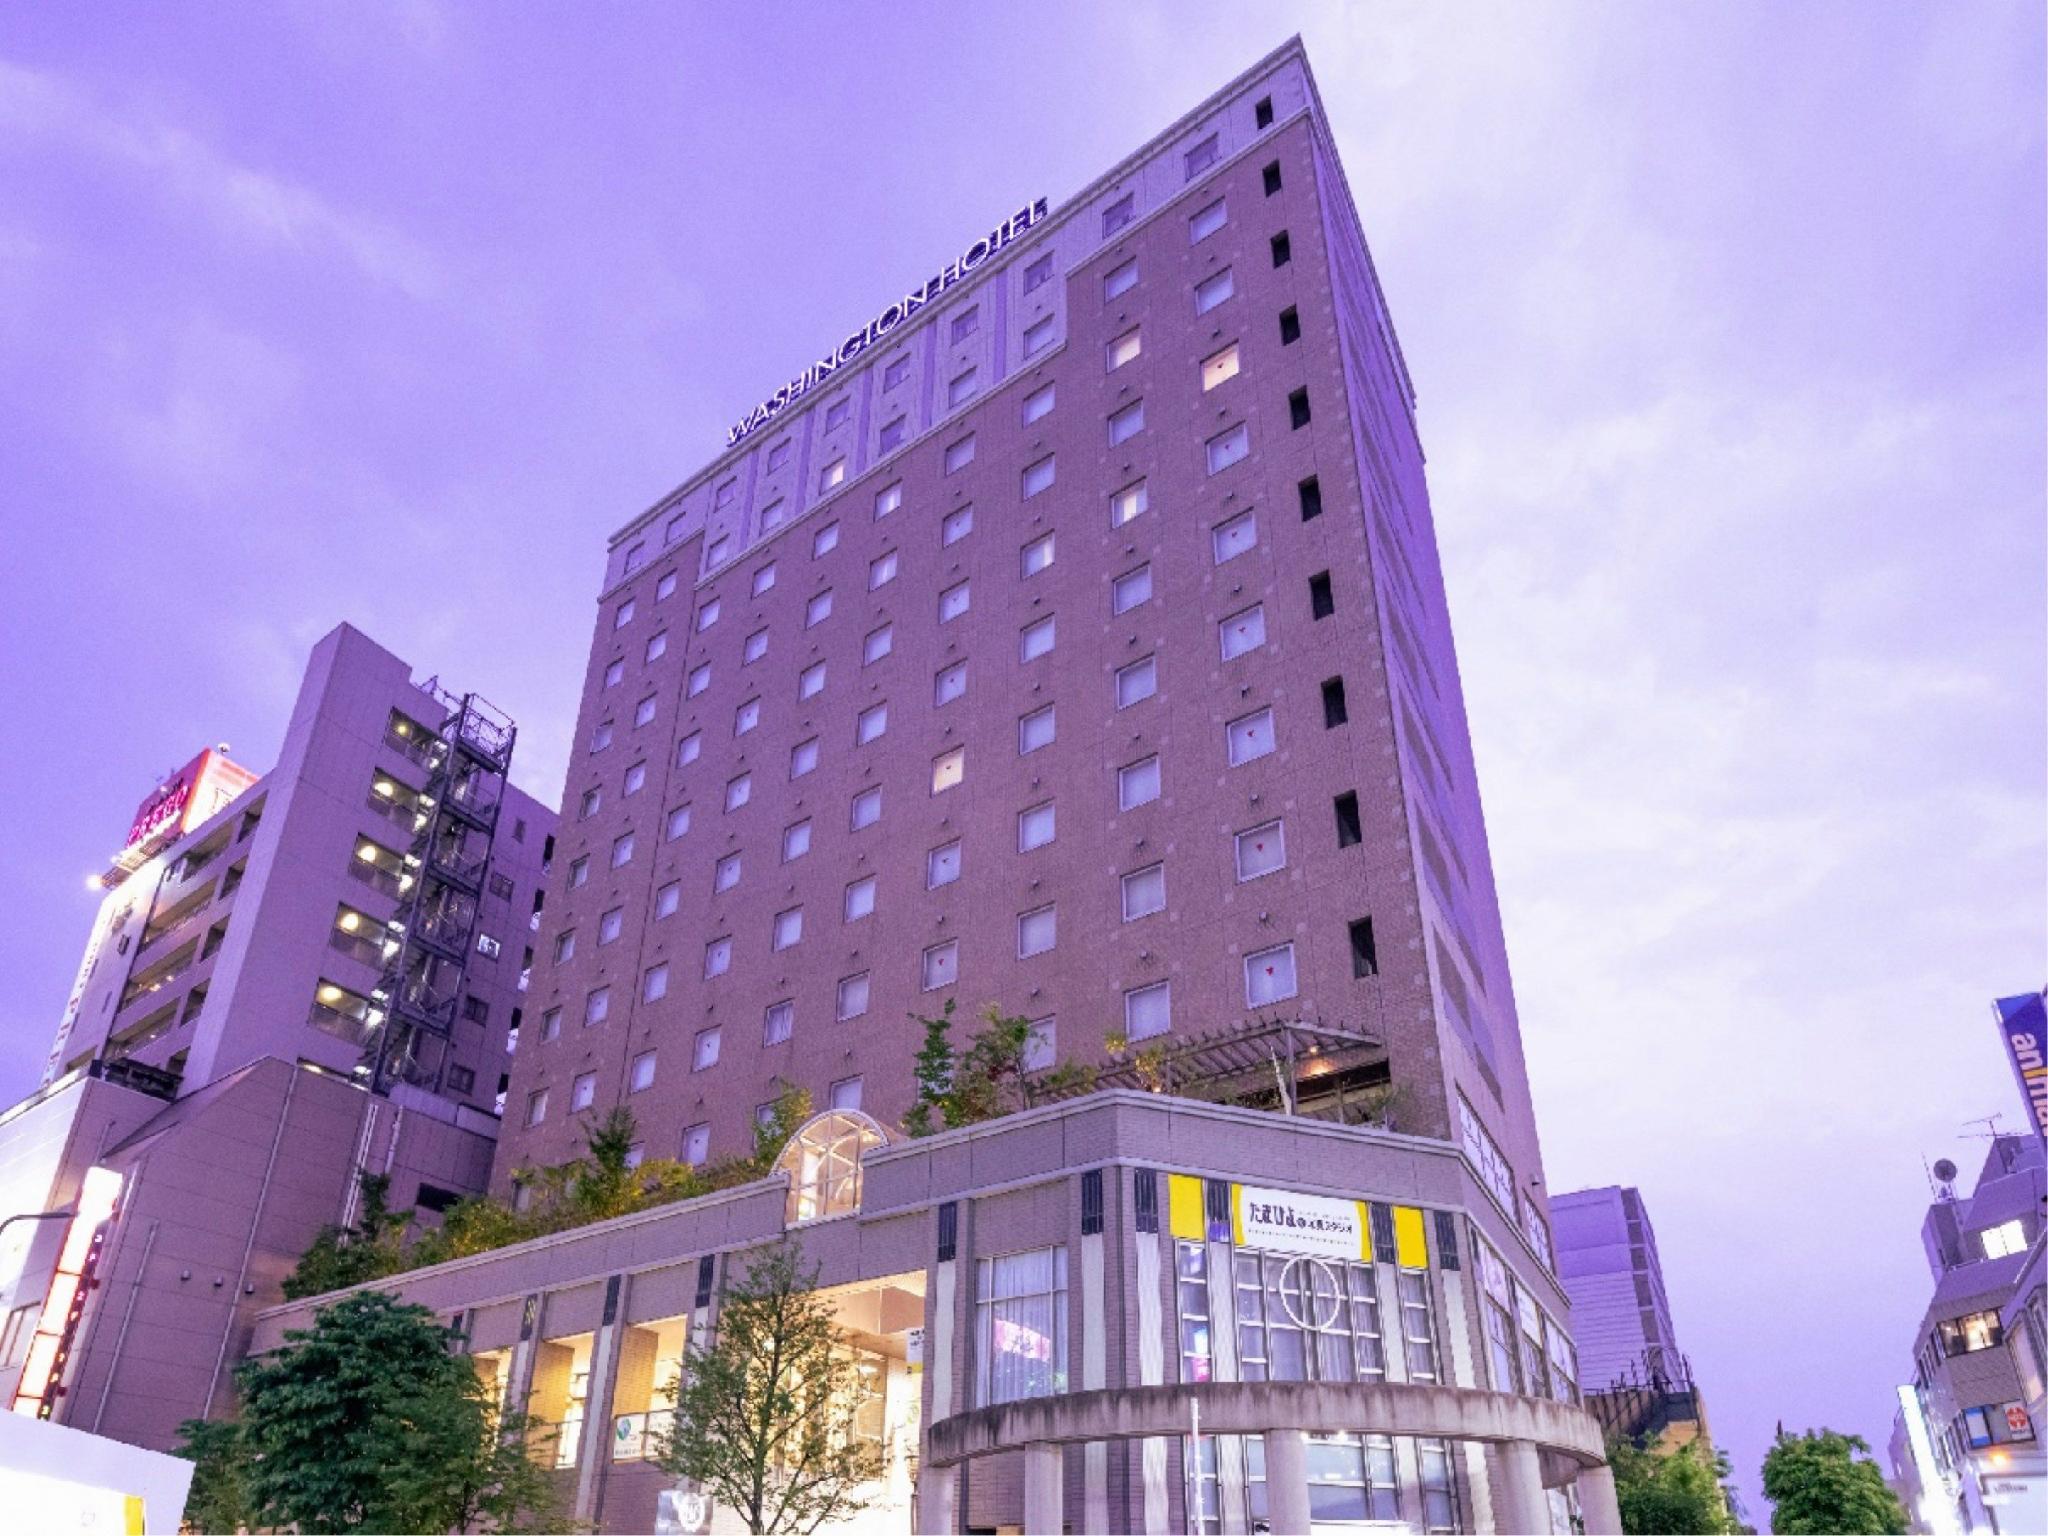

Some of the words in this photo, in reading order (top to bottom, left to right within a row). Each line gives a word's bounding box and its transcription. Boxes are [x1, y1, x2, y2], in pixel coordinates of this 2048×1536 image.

[728, 280, 928, 443] WASHINGTON
[939, 197, 1047, 291] HOTEL
[2012, 1033, 2048, 1136] anima
